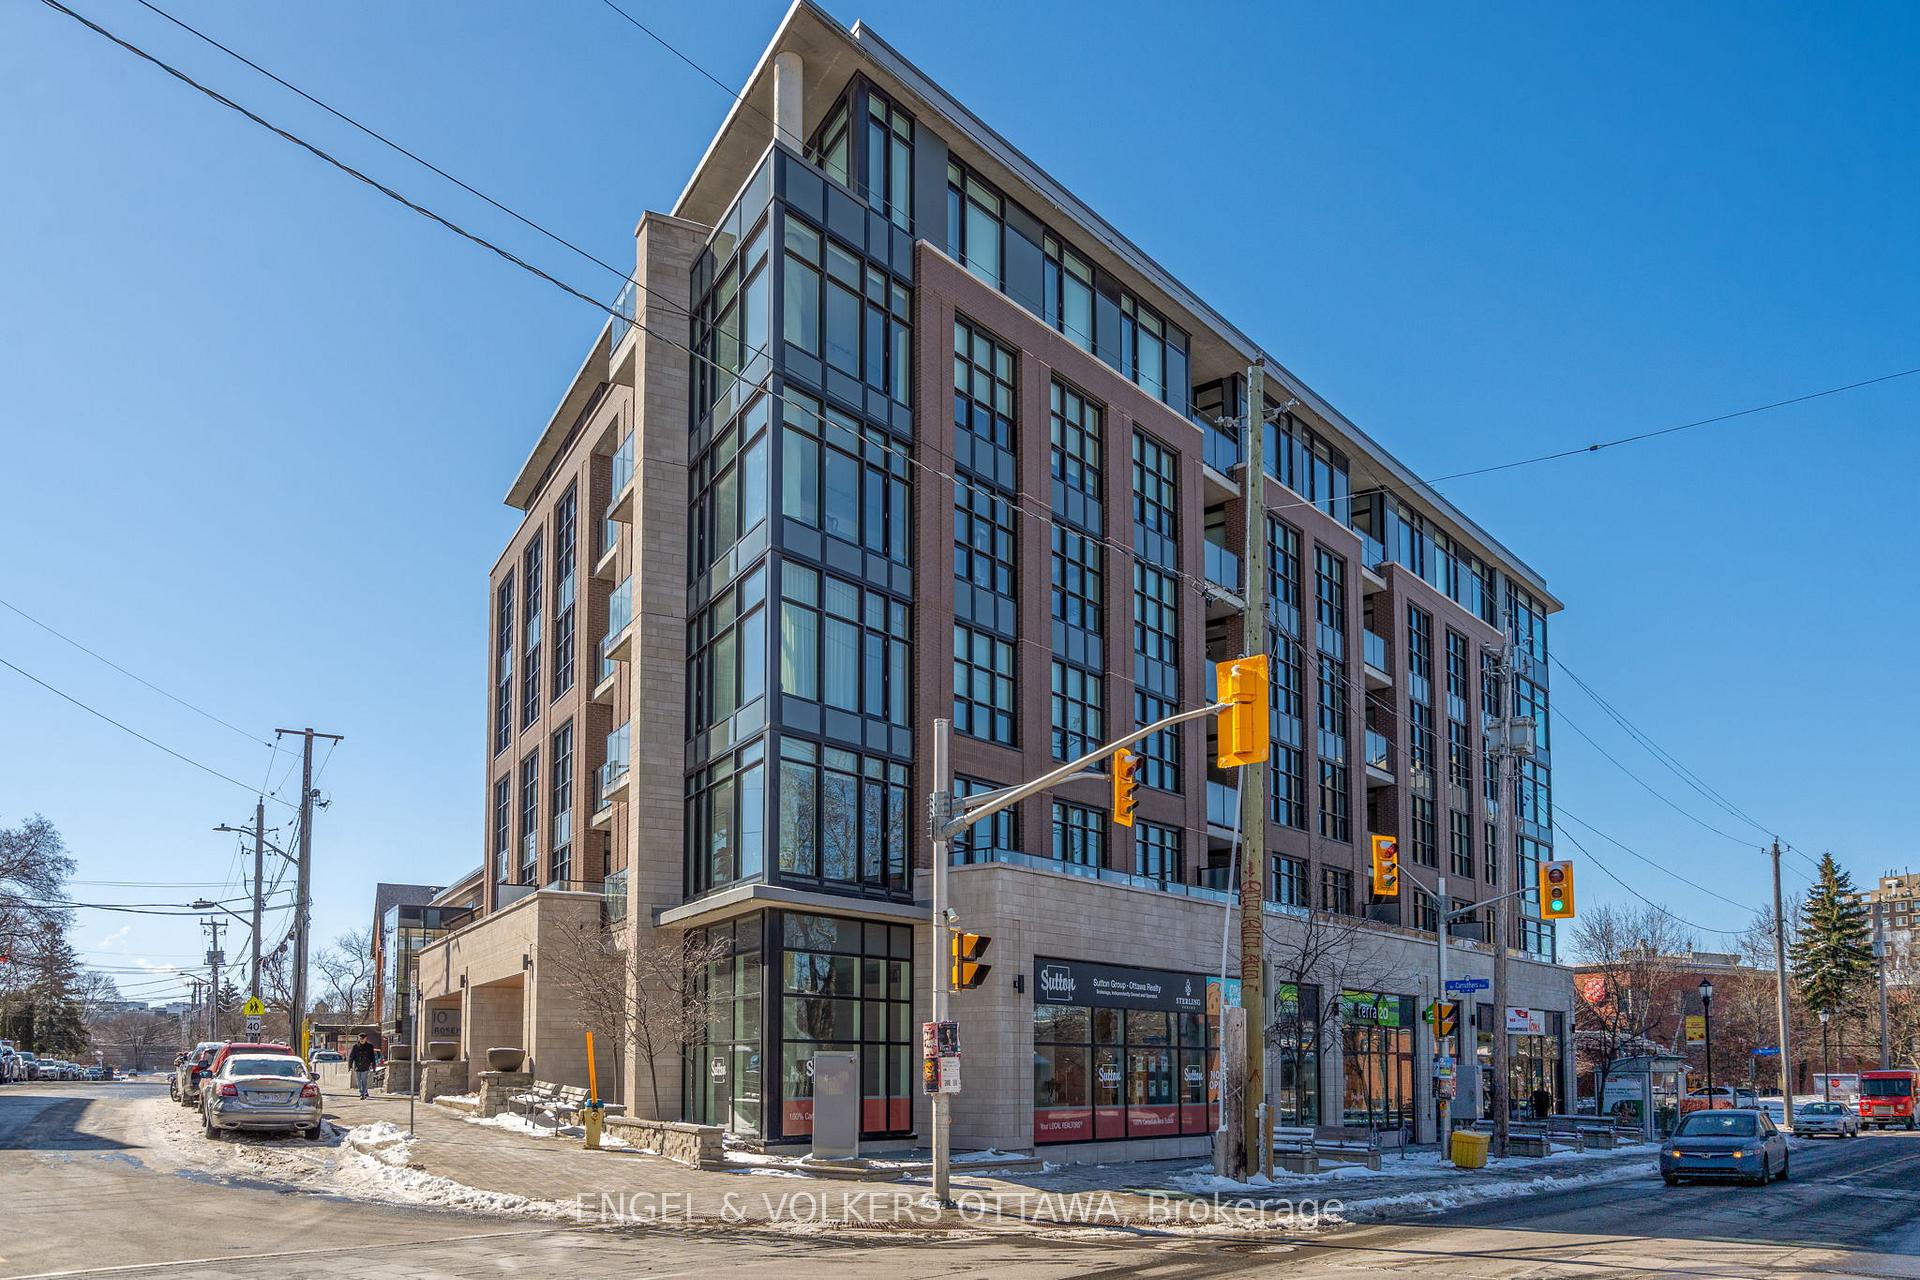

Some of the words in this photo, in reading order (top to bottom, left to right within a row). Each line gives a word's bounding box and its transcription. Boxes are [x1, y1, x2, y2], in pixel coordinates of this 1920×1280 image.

[1041, 969, 1076, 992] Sutton
[1093, 978, 1110, 988] Sutton
[1111, 980, 1126, 990] Group
[1129, 982, 1146, 990] Ottawa
[1146, 983, 1162, 994] Realty
[1176, 998, 1200, 1006] STERLING
[1099, 1068, 1121, 1082] Sutton
[1184, 1068, 1203, 1080] Sutton
[1210, 1070, 1220, 1079] NO
[1209, 1080, 1220, 1090] OP
[789, 1112, 804, 1120] 100%
